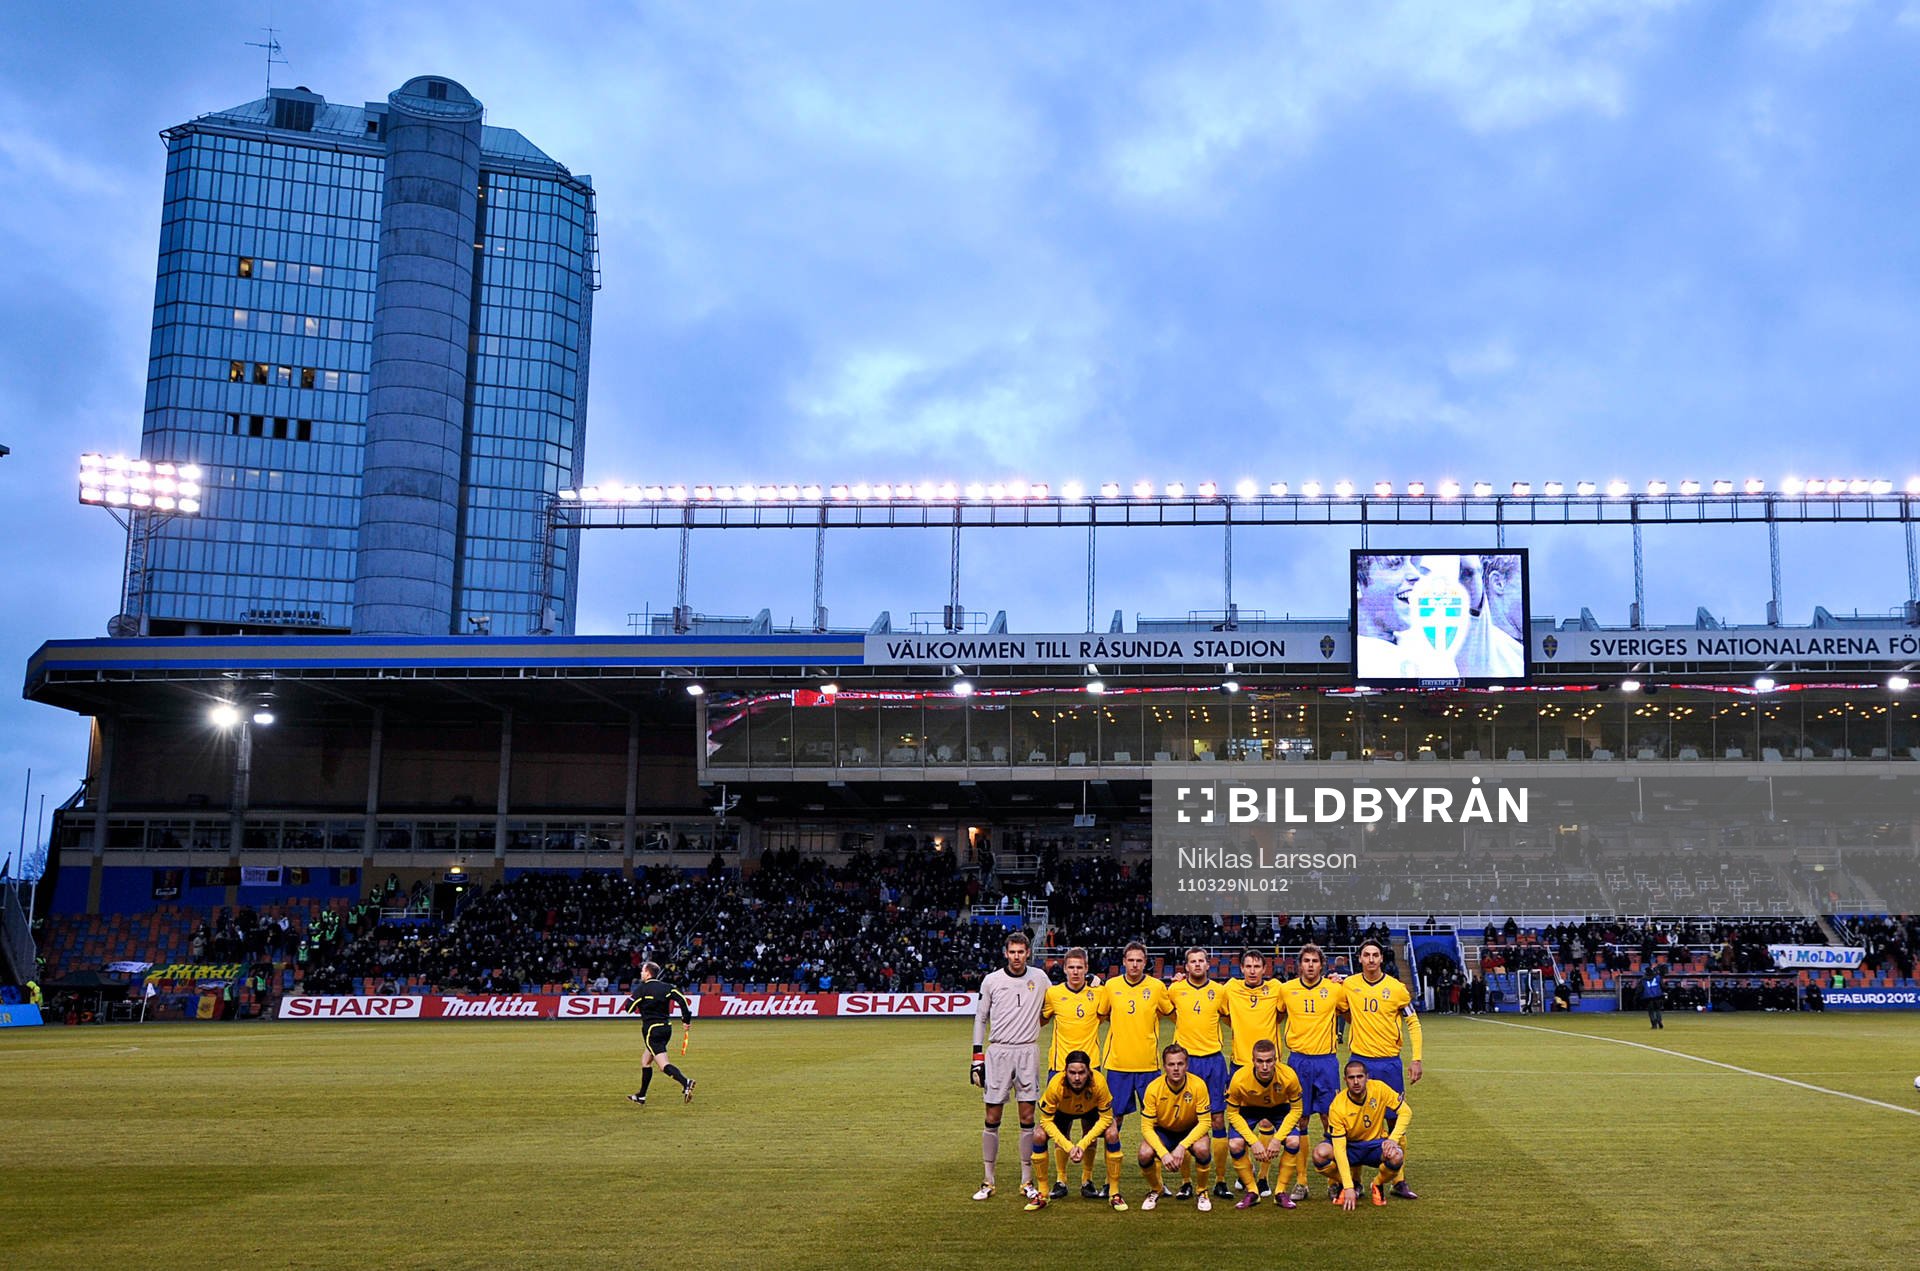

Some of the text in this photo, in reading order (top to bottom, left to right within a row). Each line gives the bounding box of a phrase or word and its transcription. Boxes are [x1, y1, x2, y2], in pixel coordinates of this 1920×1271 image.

[887, 637, 1285, 659] VÄLKOMMEN TILL RÅSUNDA STADION
[1589, 633, 1920, 656] SVERIGES NATIONALARENA FÖ
[845, 995, 971, 1013] SHARP
[1015, 993, 1022, 1007] 1
[1250, 994, 1258, 1008] 9
[1886, 993, 1916, 1003] 2012
[287, 998, 415, 1016] SHARP
[1076, 1004, 1085, 1018] 6
[1127, 1000, 1136, 1014] 3
[1193, 1000, 1201, 1014] 4
[1303, 999, 1316, 1013] 11
[1363, 998, 1379, 1013] 10
[1074, 1103, 1084, 1113] 2
[1173, 1104, 1180, 1118] 7
[1362, 1114, 1372, 1129] 8
